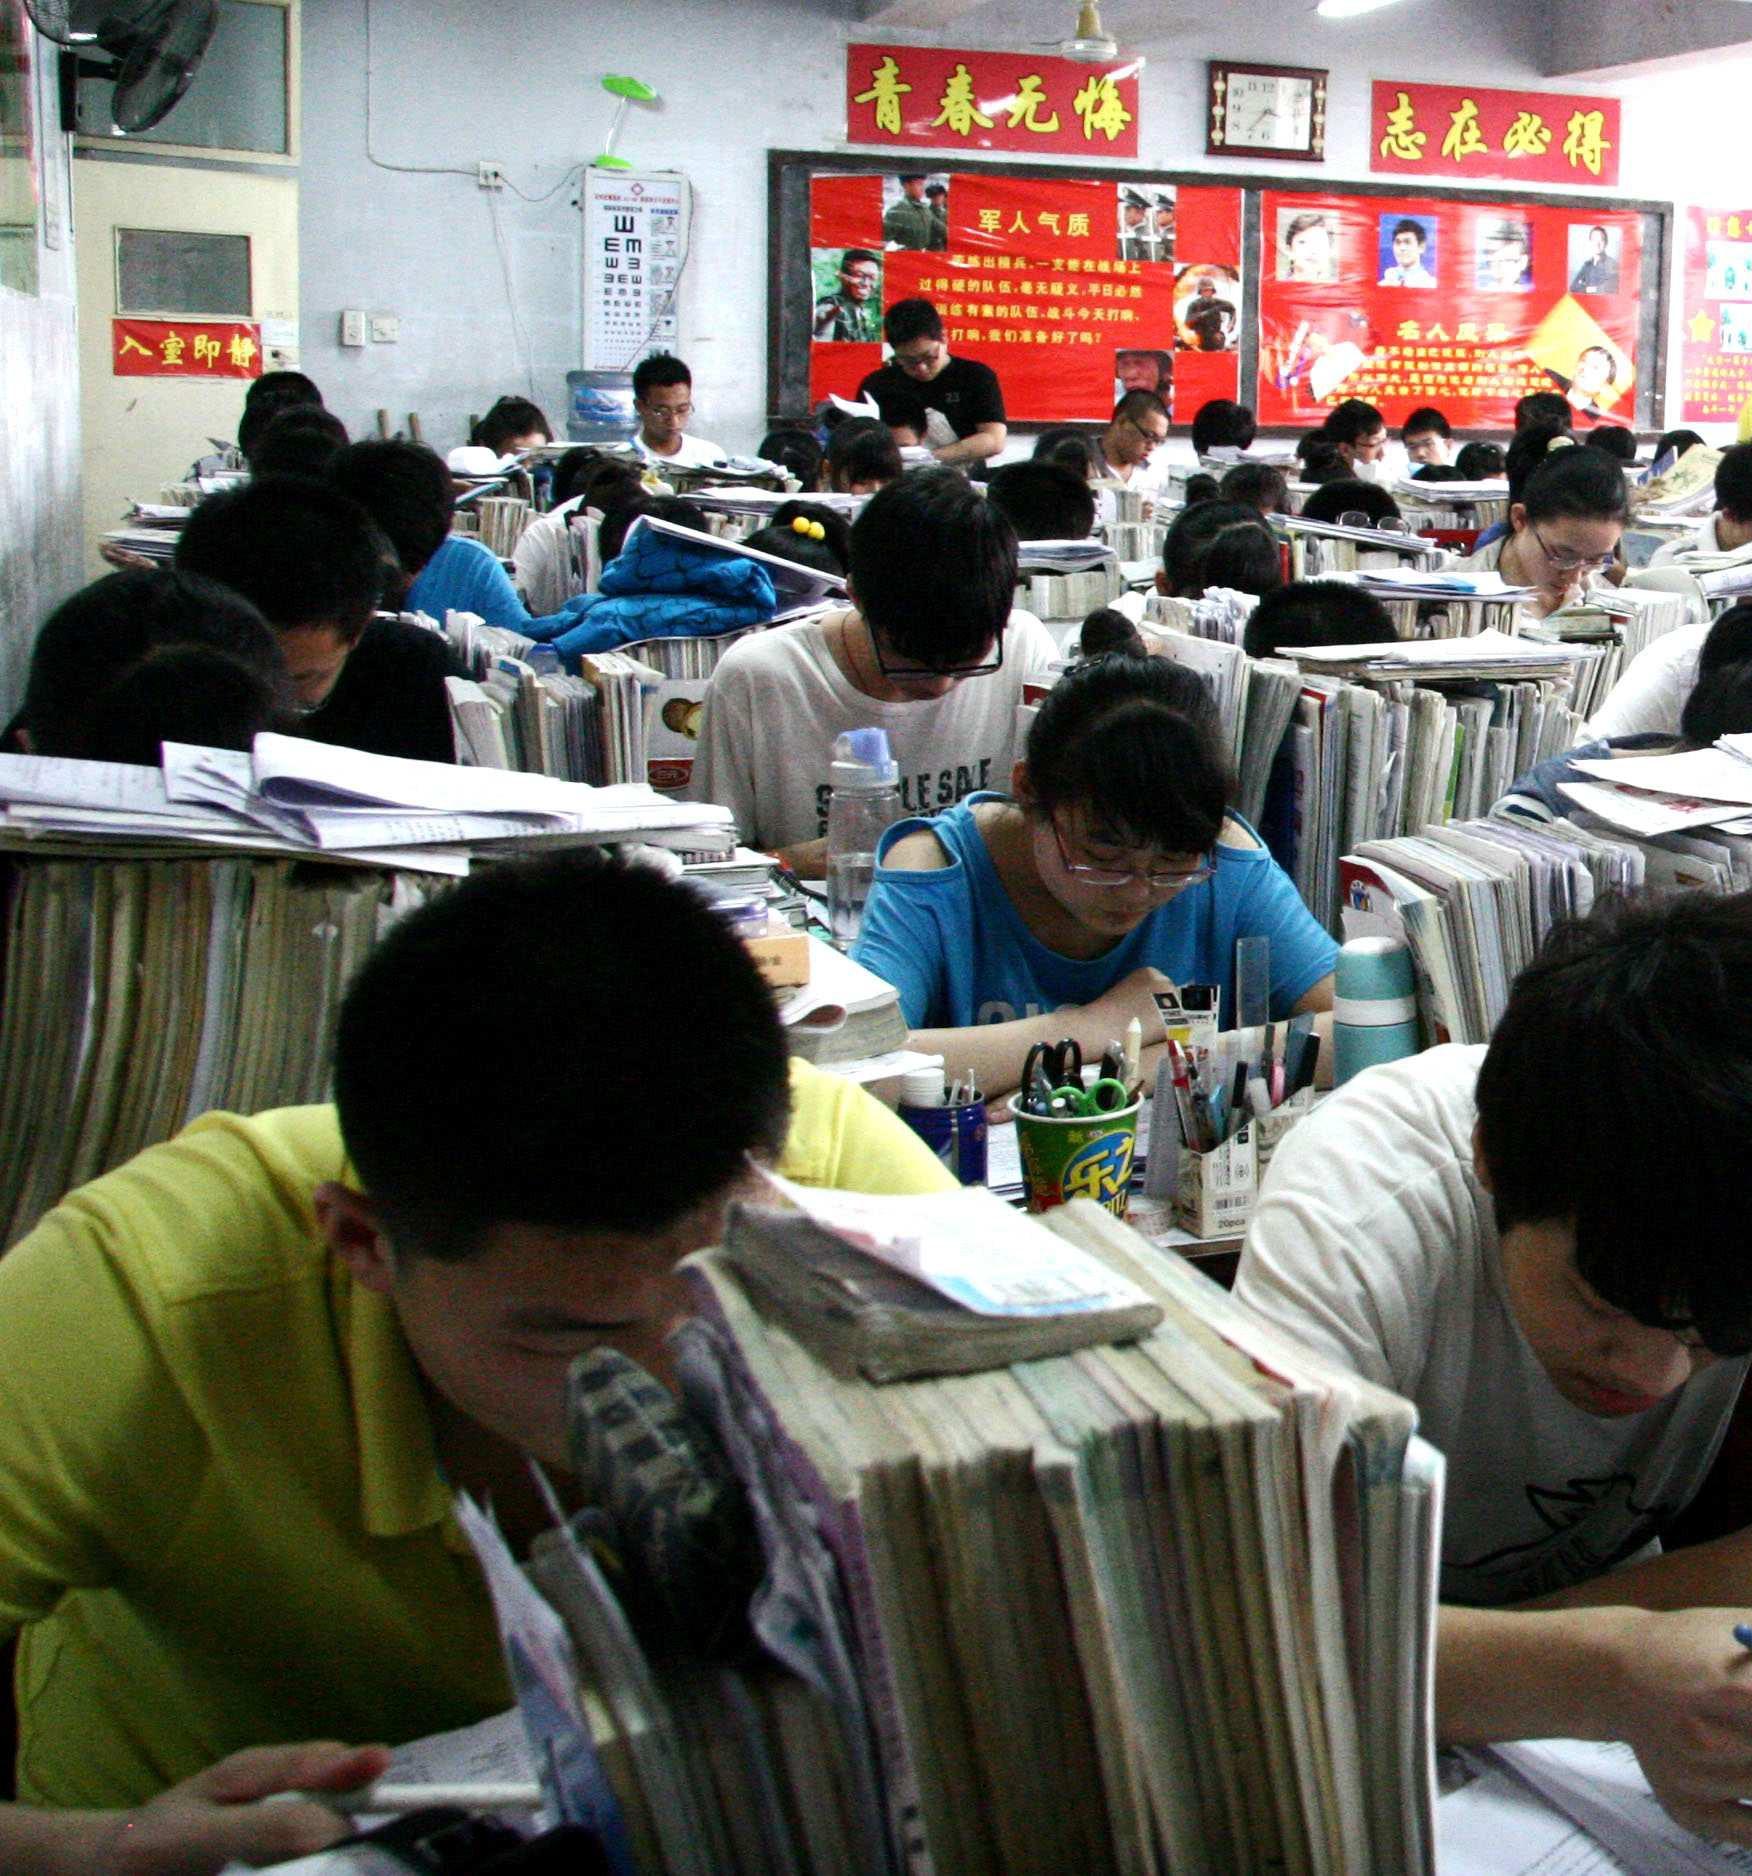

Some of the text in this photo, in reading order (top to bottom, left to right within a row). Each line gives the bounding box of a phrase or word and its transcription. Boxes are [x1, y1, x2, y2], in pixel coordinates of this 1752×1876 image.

[854, 56, 1133, 141] 青春无悔
[1380, 91, 1613, 175] 志在必得
[978, 207, 1091, 238] 军人气质
[119, 331, 257, 368] 入室即静
